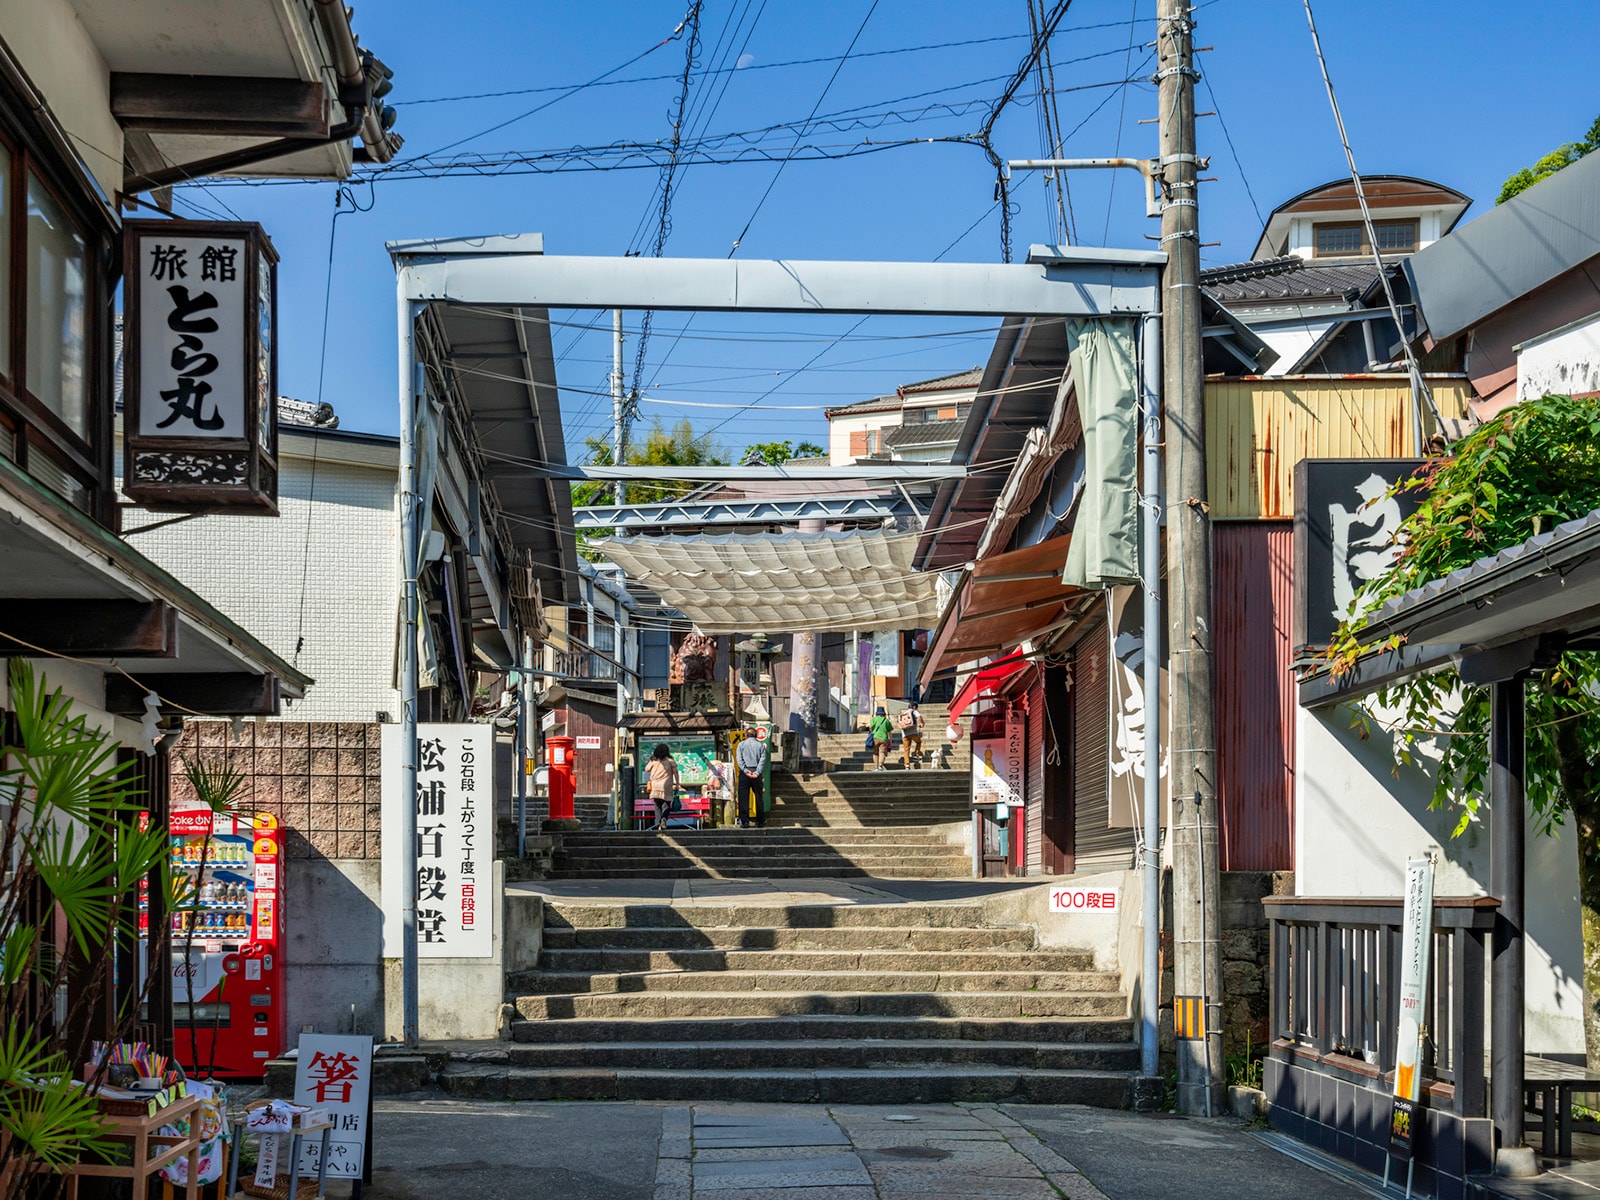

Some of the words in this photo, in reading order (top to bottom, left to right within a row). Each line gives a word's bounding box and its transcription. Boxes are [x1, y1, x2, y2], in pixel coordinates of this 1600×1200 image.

[150, 244, 239, 283] 旅館
[155, 284, 225, 431] とら丸
[460, 738, 475, 792] この石段
[169, 815, 194, 826] Coke
[416, 737, 447, 944] 松浦百段堂
[1052, 889, 1116, 910] 100段目
[305, 1050, 360, 1104] 箸
